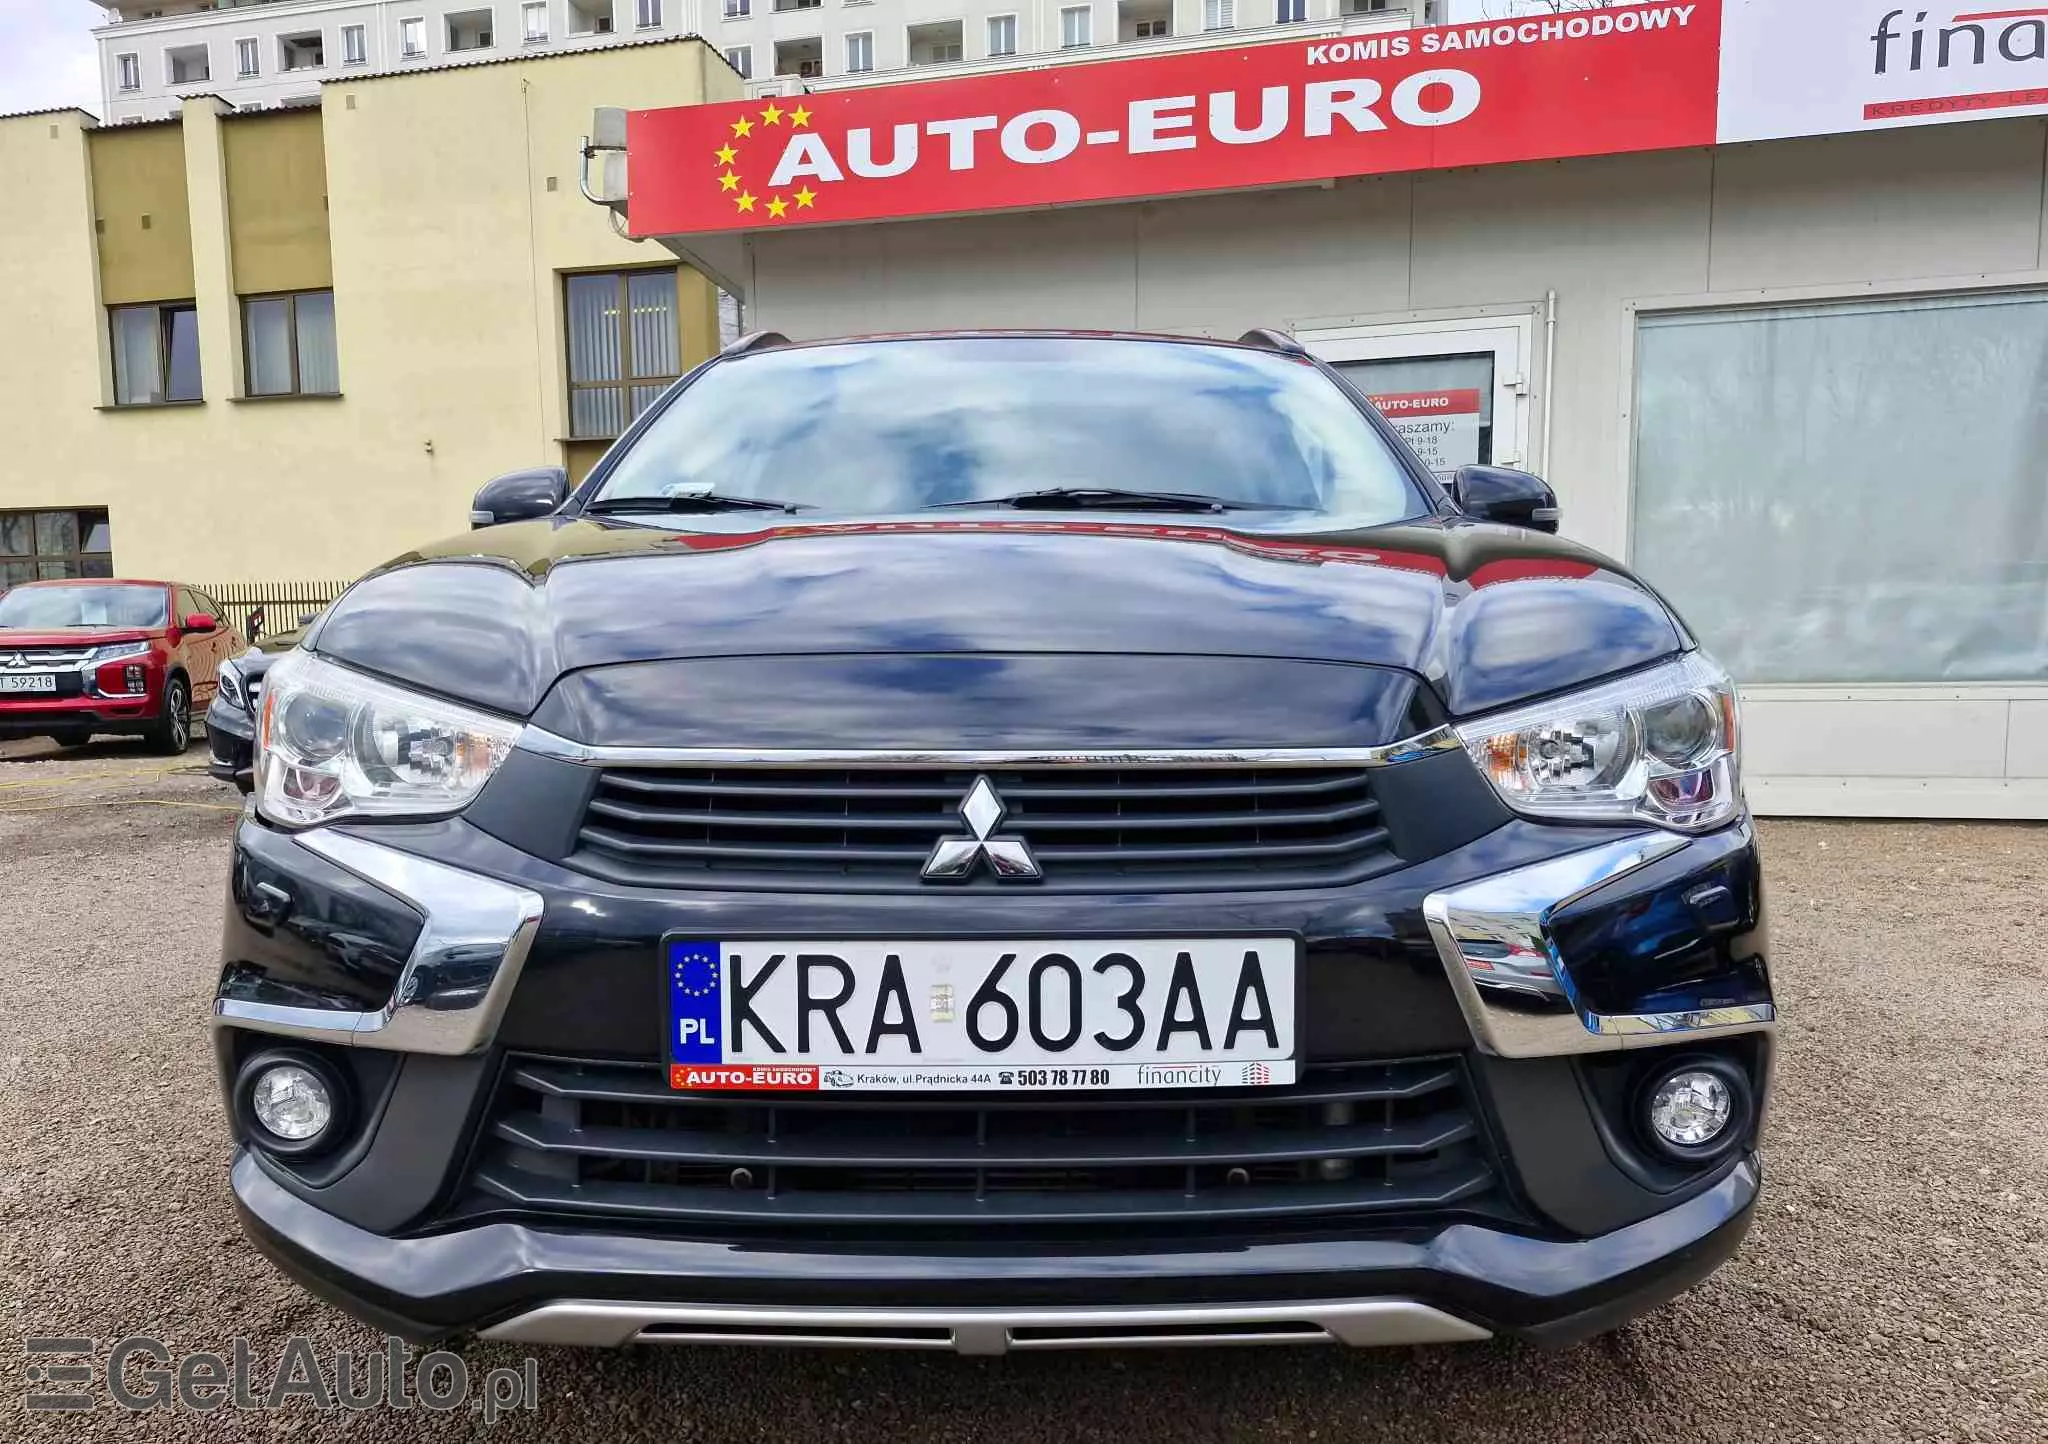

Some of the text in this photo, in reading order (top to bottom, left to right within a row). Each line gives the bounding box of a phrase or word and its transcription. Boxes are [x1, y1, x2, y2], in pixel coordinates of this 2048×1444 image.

[1307, 5, 1697, 65] KOMIS SAMOCHODOWY
[1872, 97, 1992, 116] KREDYTY
[768, 69, 1482, 187] AUTO-EURO
[11, 676, 53, 689] 59218
[728, 951, 1280, 1054] KRA 603AA
[680, 1018, 715, 1045] PL
[686, 1071, 813, 1086] AUTO-EURO
[857, 1073, 900, 1086] Kraków,
[970, 1073, 992, 1084] 44A
[1018, 1070, 1047, 1086] 503
[1051, 1070, 1069, 1085] 78
[1137, 1064, 1222, 1086] financity
